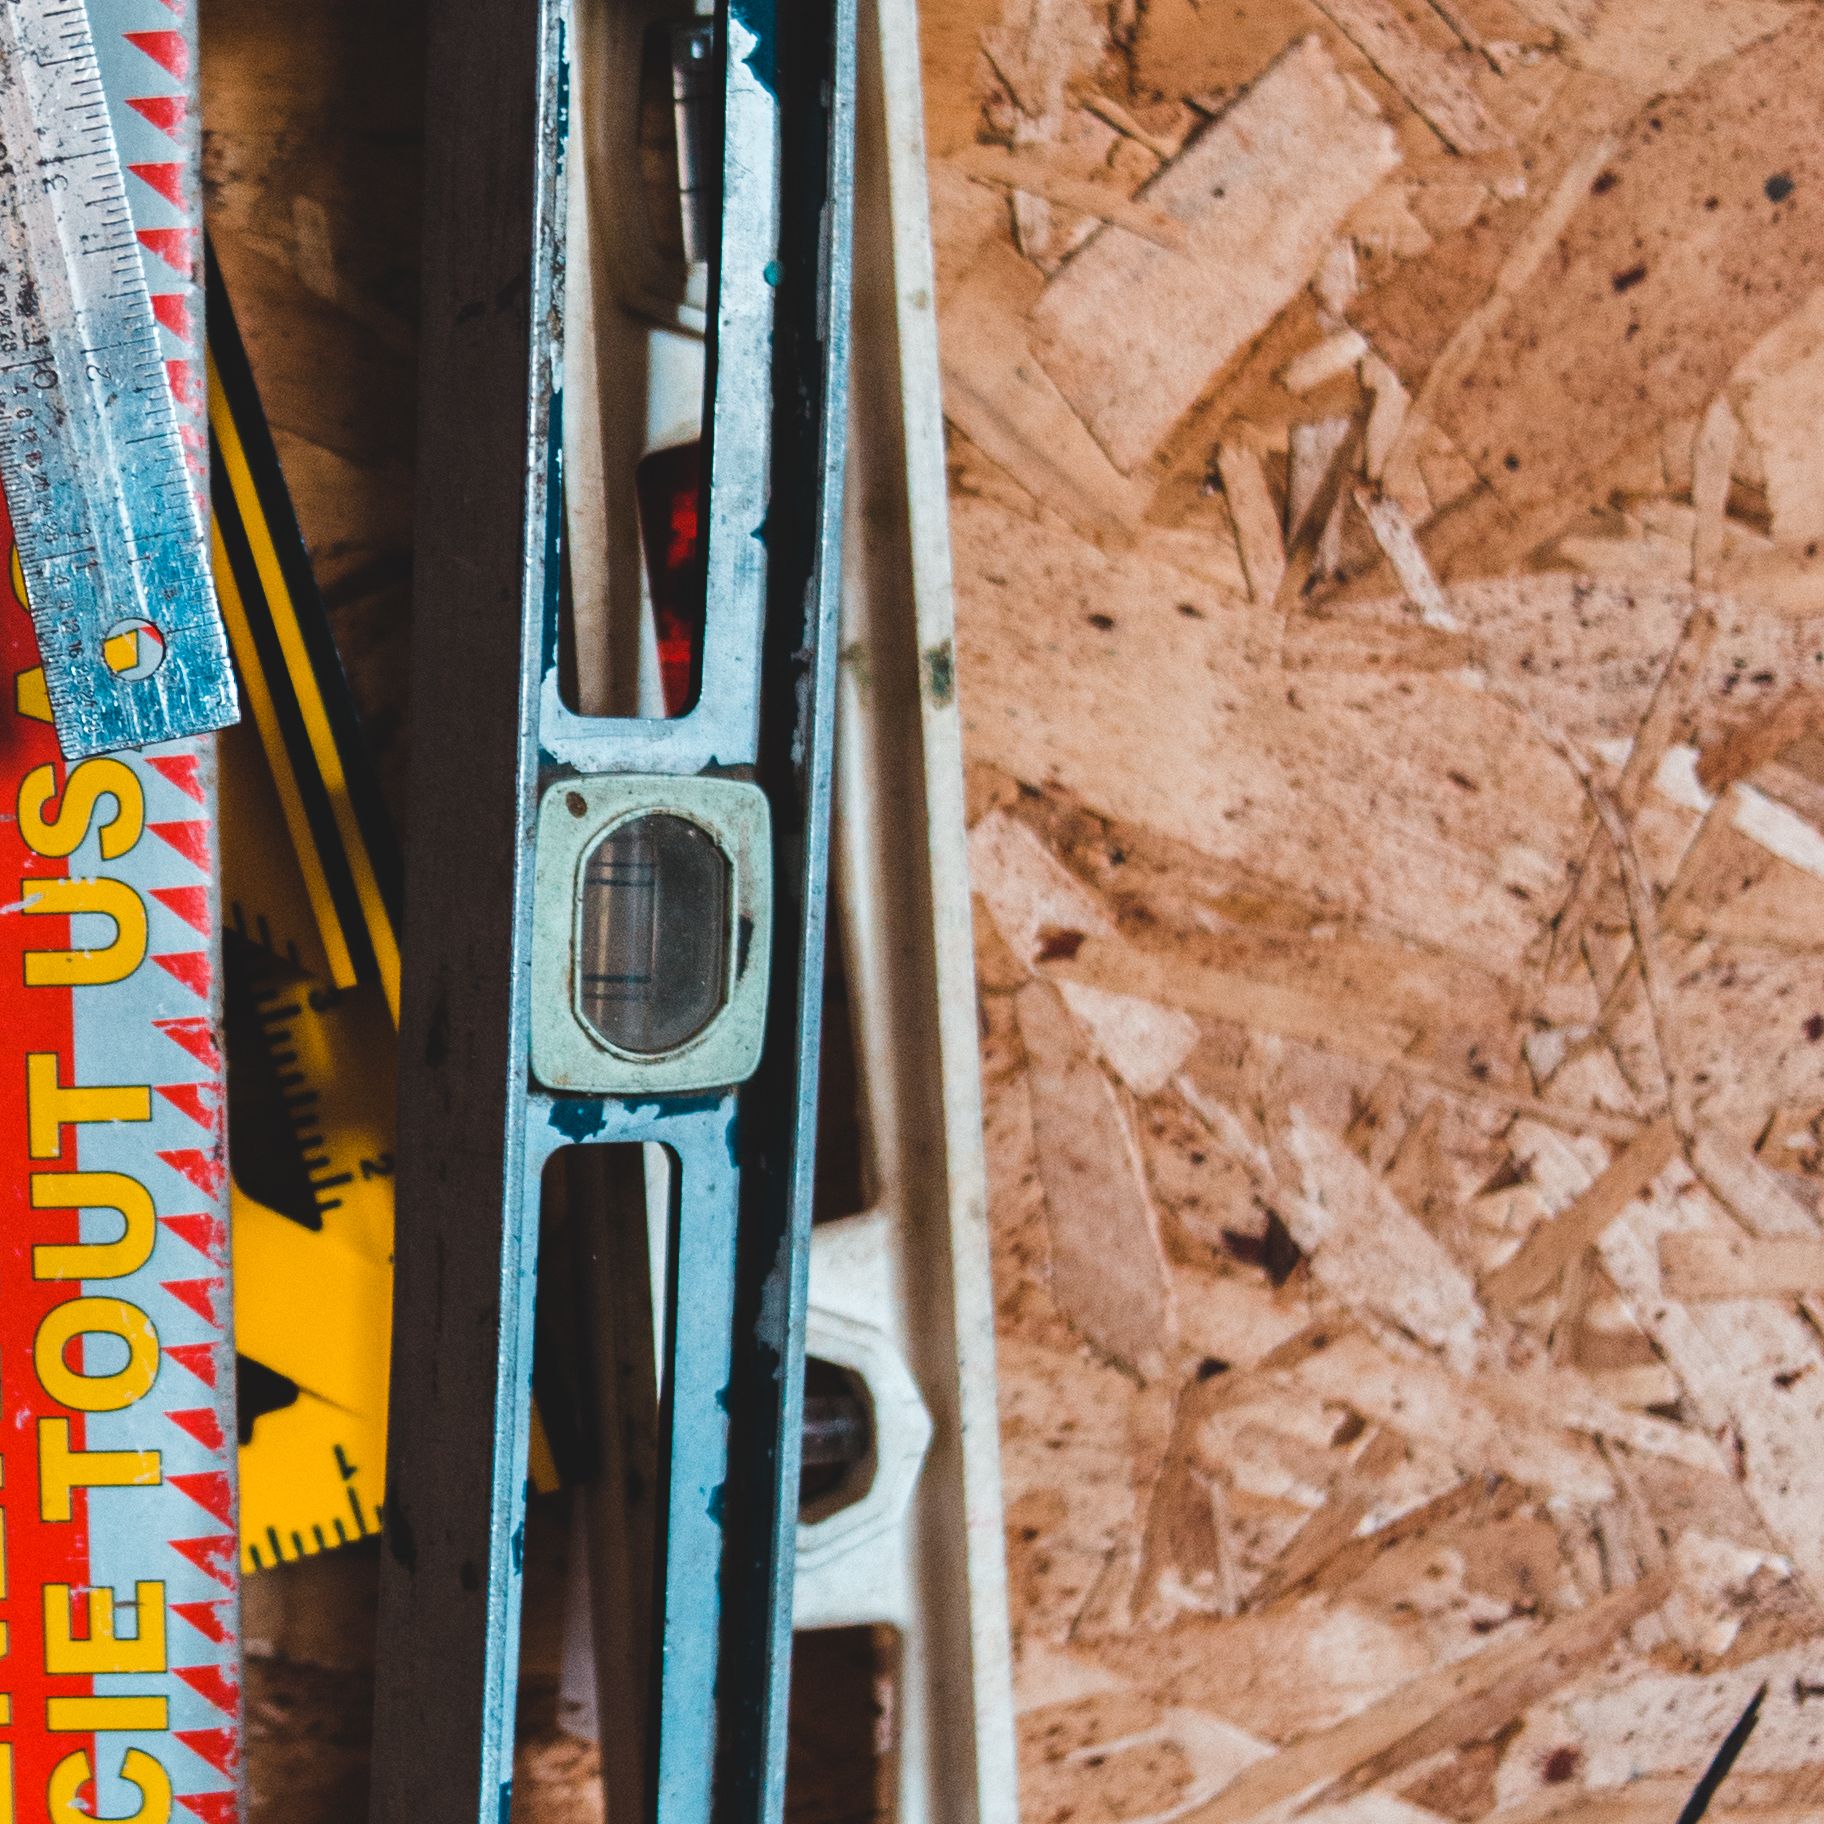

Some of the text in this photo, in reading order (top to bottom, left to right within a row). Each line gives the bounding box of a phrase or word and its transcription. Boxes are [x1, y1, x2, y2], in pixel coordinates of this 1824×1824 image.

[41, 173, 69, 193] 3
[84, 362, 111, 383] 2
[359, 1151, 395, 1180] 2
[28, 1052, 161, 1522] TOUT
[334, 1443, 358, 1481] 1
